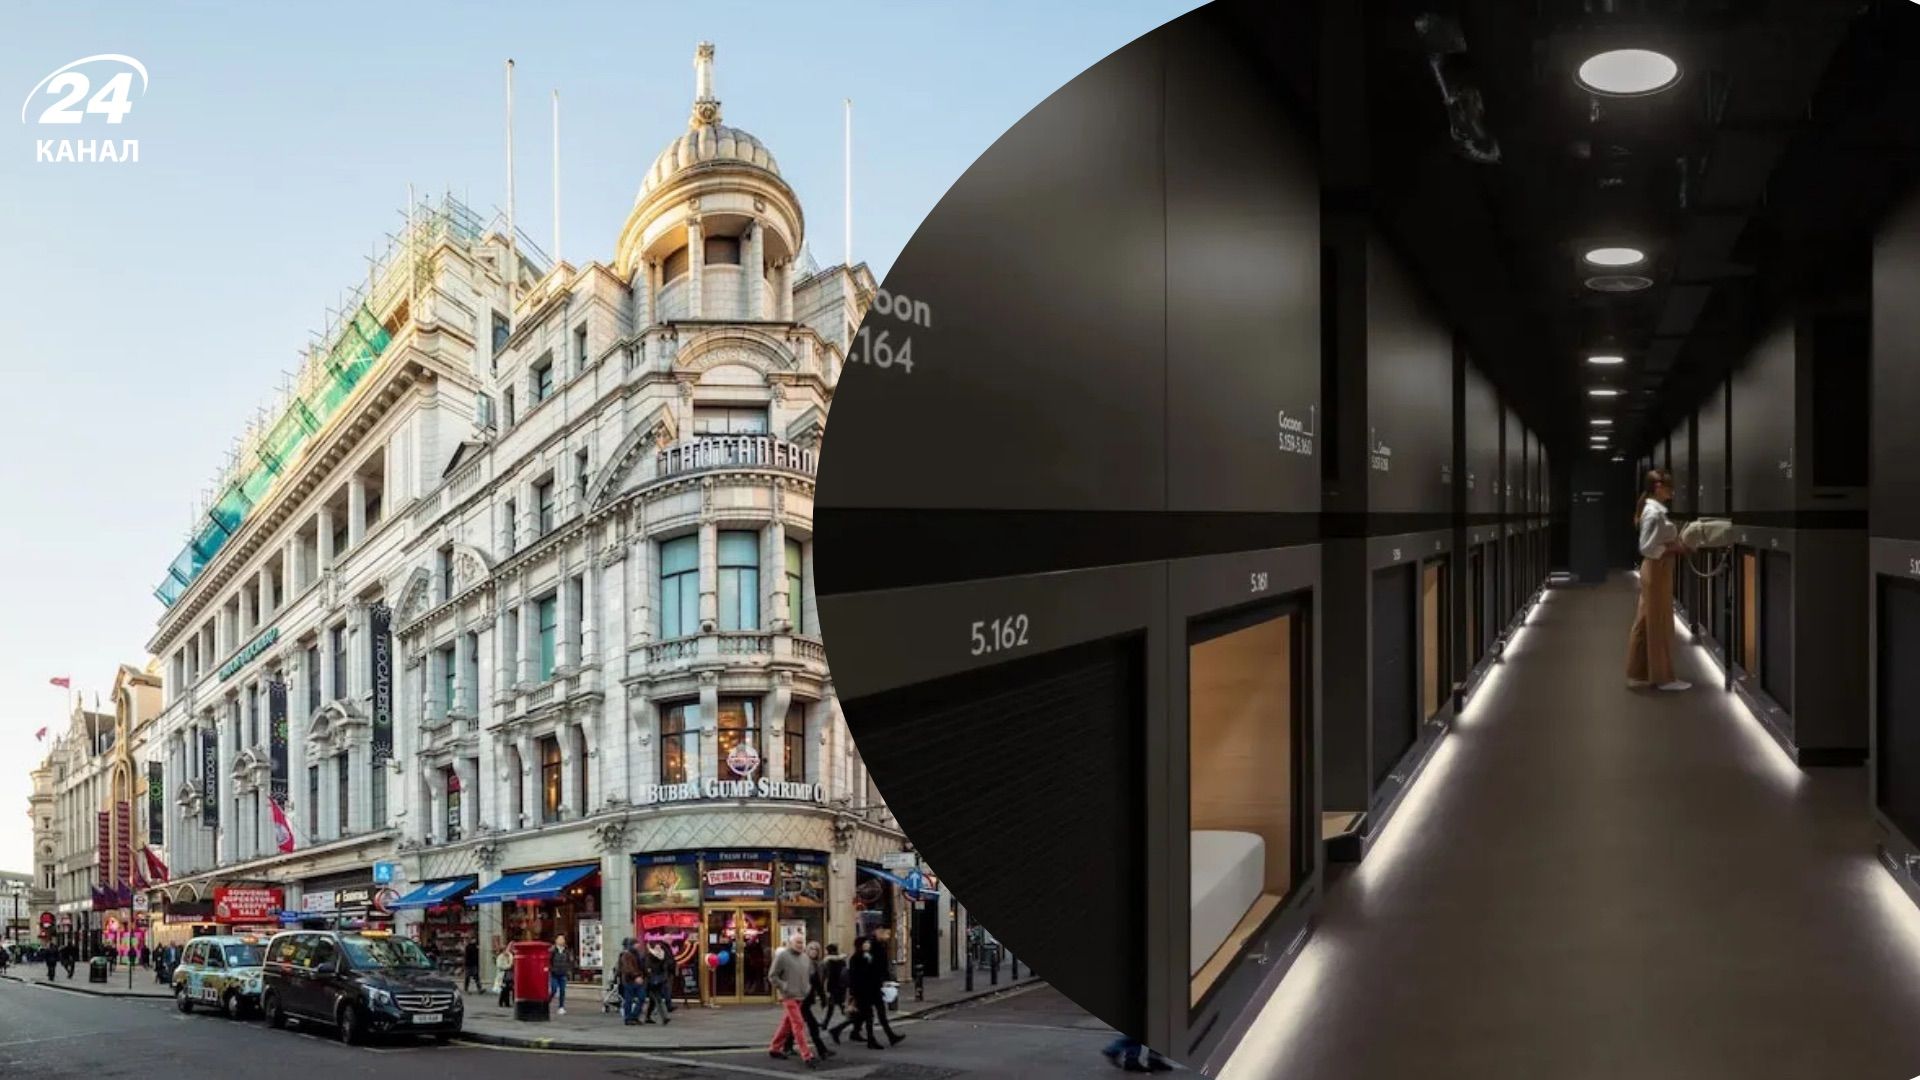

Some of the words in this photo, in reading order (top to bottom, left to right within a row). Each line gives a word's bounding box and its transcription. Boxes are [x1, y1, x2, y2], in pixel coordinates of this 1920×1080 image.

[971, 613, 1029, 656] 5.162
[377, 634, 389, 726] TROCADERO
[649, 782, 700, 803] BUBBA
[705, 777, 755, 798] GUMP
[758, 776, 812, 800] SHRIMP
